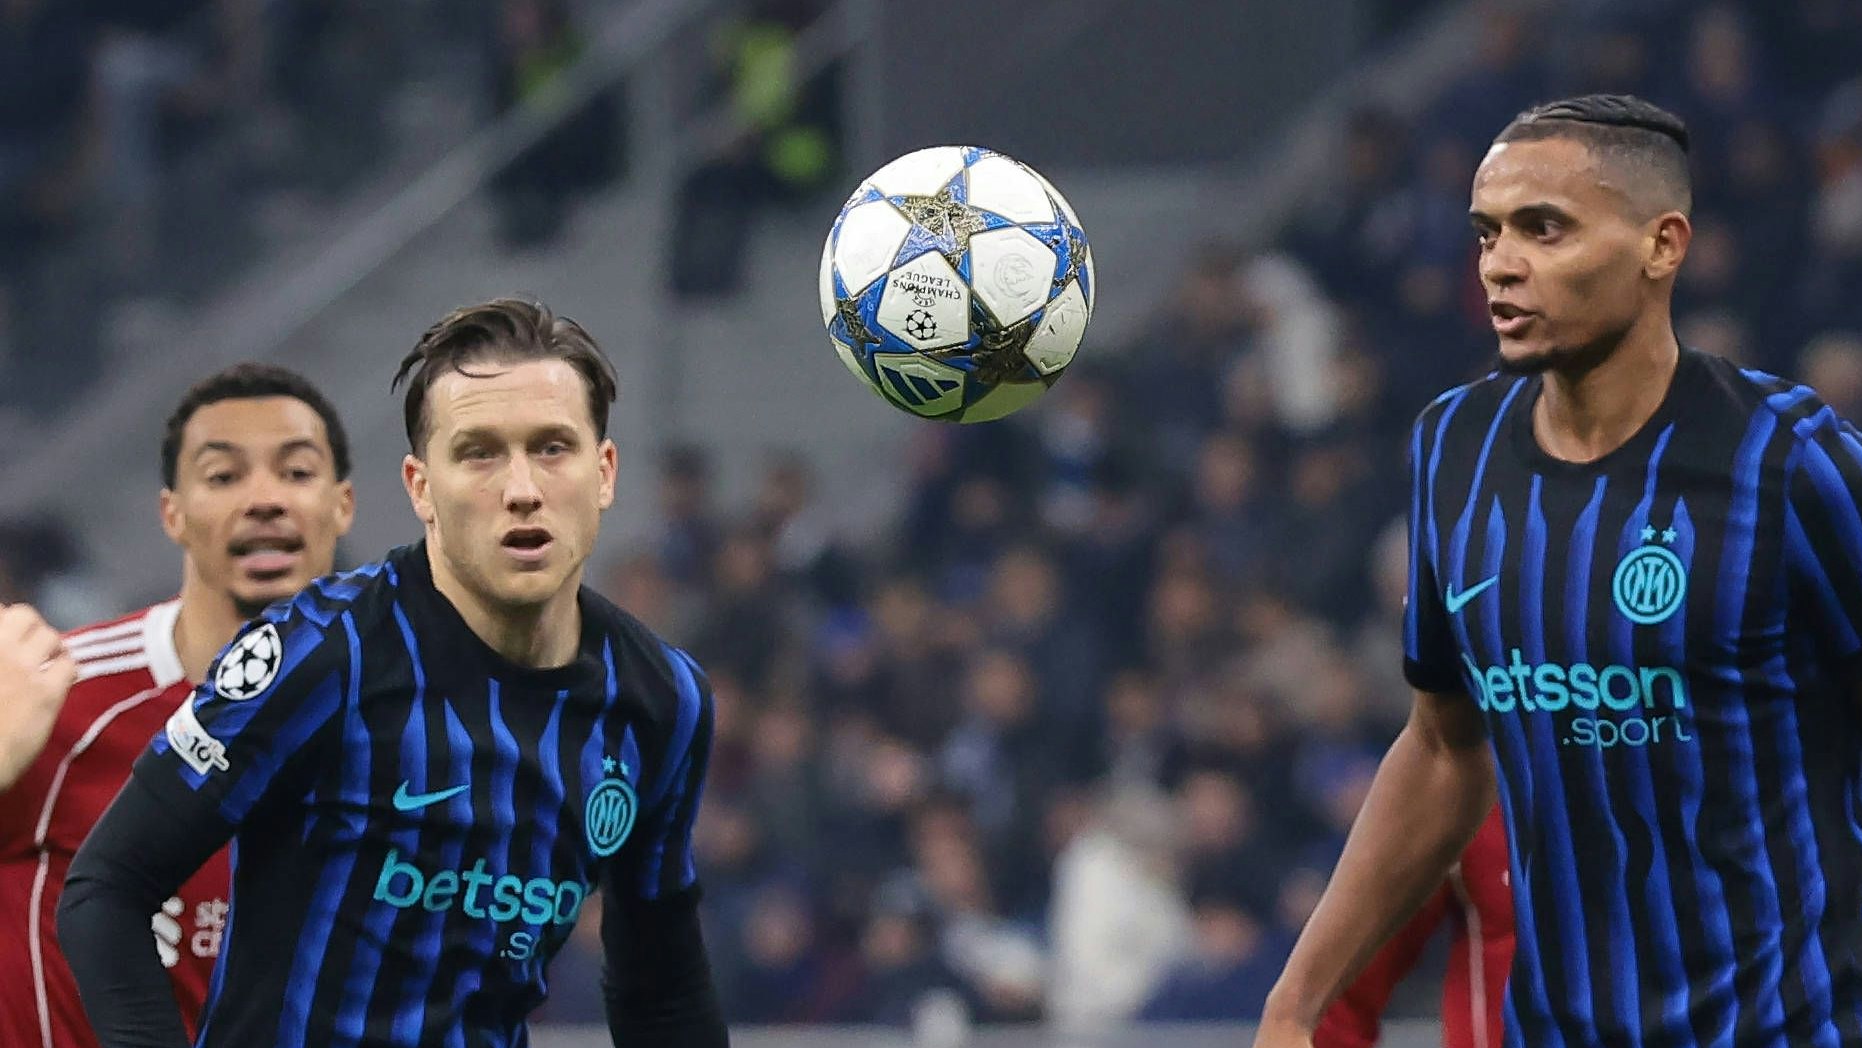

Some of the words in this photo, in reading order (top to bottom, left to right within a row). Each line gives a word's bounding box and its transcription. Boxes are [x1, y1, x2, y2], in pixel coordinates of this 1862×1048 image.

[893, 279, 962, 300] CHAMPIONS
[905, 271, 951, 288] LEAGUE
[373, 849, 591, 926] betsso
